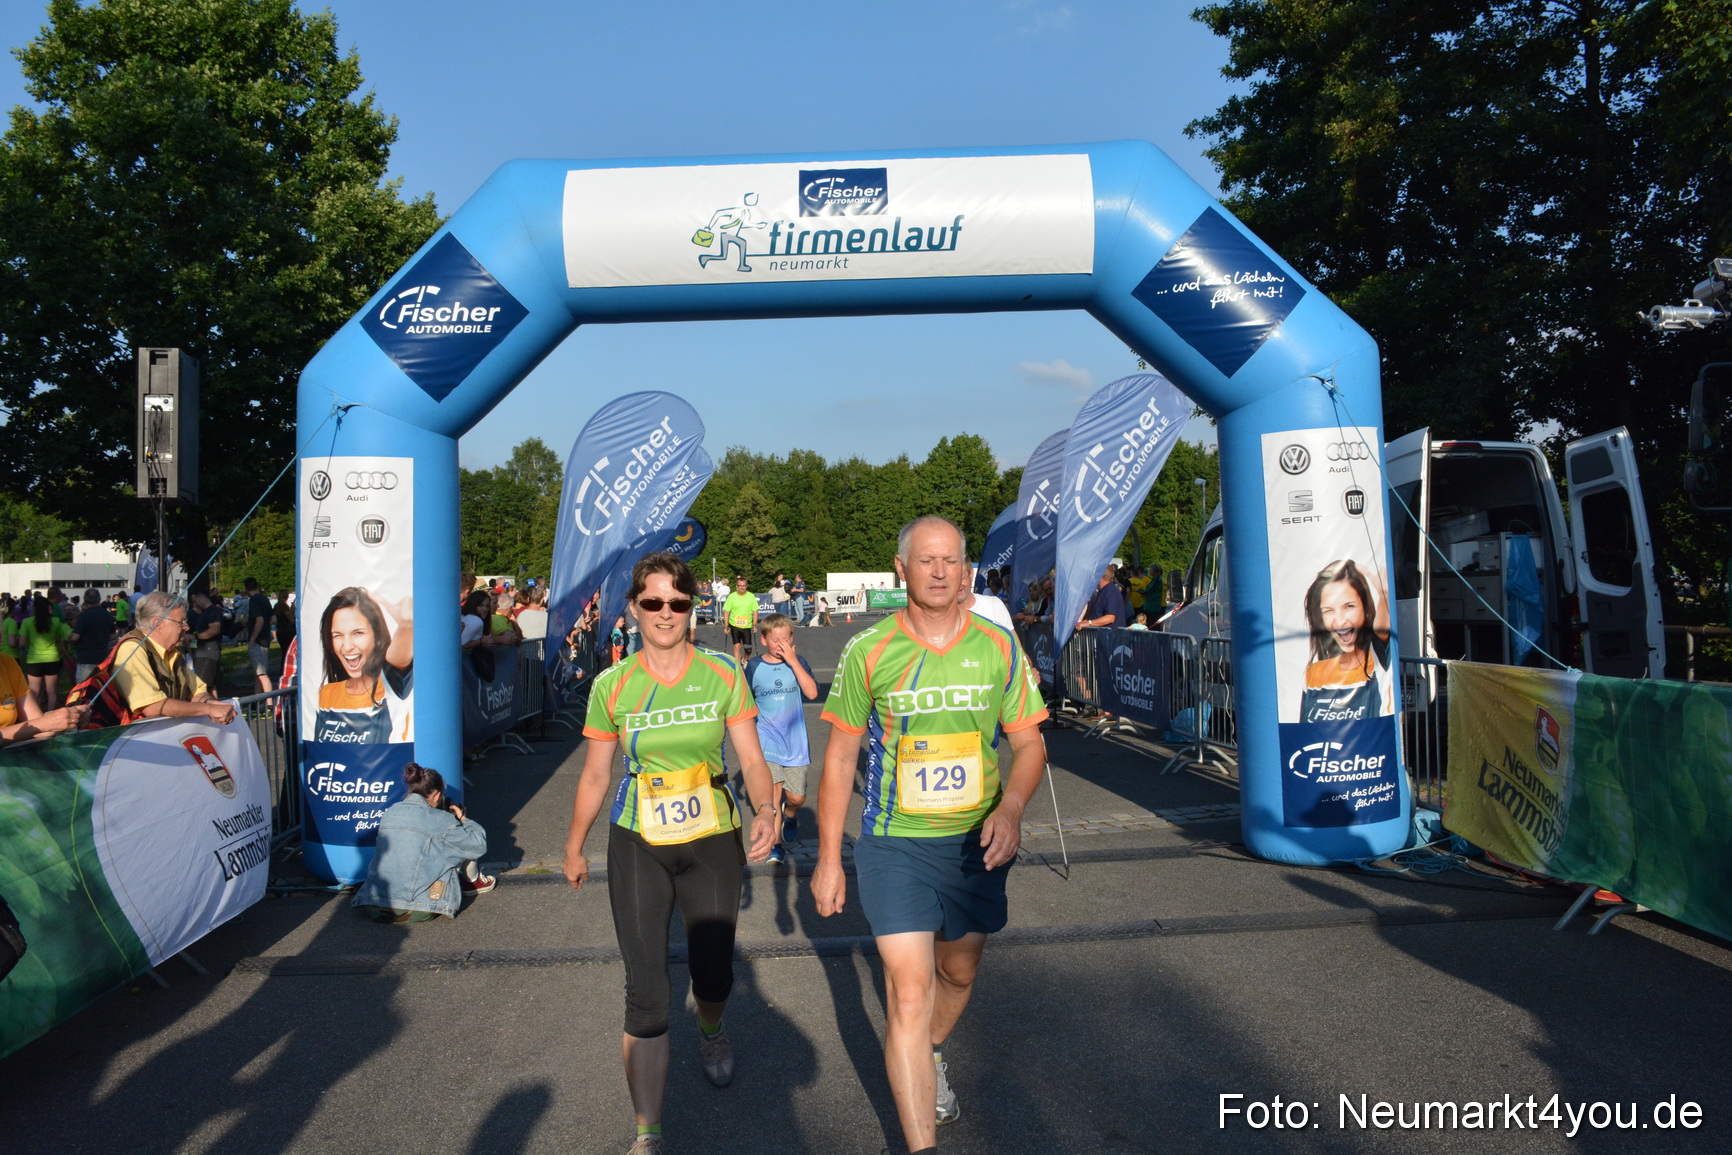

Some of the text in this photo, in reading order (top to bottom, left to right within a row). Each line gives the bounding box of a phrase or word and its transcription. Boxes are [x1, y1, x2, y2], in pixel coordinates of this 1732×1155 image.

[818, 185, 882, 198] Fischer
[824, 197, 877, 205] AUTOMOBILE
[768, 214, 965, 255] firmenlauf
[769, 256, 849, 271] neumarkt
[1172, 276, 1201, 293] und
[1205, 274, 1232, 286] das
[1234, 270, 1285, 285] Lächeln
[1210, 286, 1284, 309] fährt mit!
[397, 302, 501, 323] Fischer
[405, 324, 492, 334] AUTOMOBILE
[1092, 397, 1162, 504] Fischer
[1118, 415, 1170, 502] AUTOMOBILE
[593, 415, 673, 519] Fischer
[1329, 466, 1350, 474] Audi
[621, 435, 682, 518] AUTOMOBILE
[346, 494, 369, 502] Audi
[652, 470, 697, 534] AUTOMOBILE
[1347, 494, 1363, 510] FIAT
[1281, 515, 1322, 525] SEAT
[364, 524, 383, 538] FIAT
[308, 541, 338, 549] SEAT
[836, 595, 856, 606] swn
[1115, 667, 1155, 696] Fischer
[887, 684, 995, 717] BOCK
[1120, 694, 1154, 711] AUTOMOBILE
[625, 701, 719, 733] BOCK
[1314, 705, 1365, 720] Fischer
[323, 730, 370, 744] Fischer
[1307, 754, 1386, 774] Fischer
[317, 776, 395, 794] Fischer
[915, 765, 967, 792] 129
[1316, 770, 1382, 783] AUTOMOBILE
[323, 794, 388, 803] AUTOMOBILE
[1332, 791, 1349, 802] und
[1351, 788, 1367, 798] das
[1355, 791, 1394, 811] fährt mit!
[334, 811, 351, 821] und
[352, 810, 369, 819] das
[655, 795, 702, 826] 130
[212, 803, 266, 841] Neumarkter
[355, 821, 380, 833] fährt
